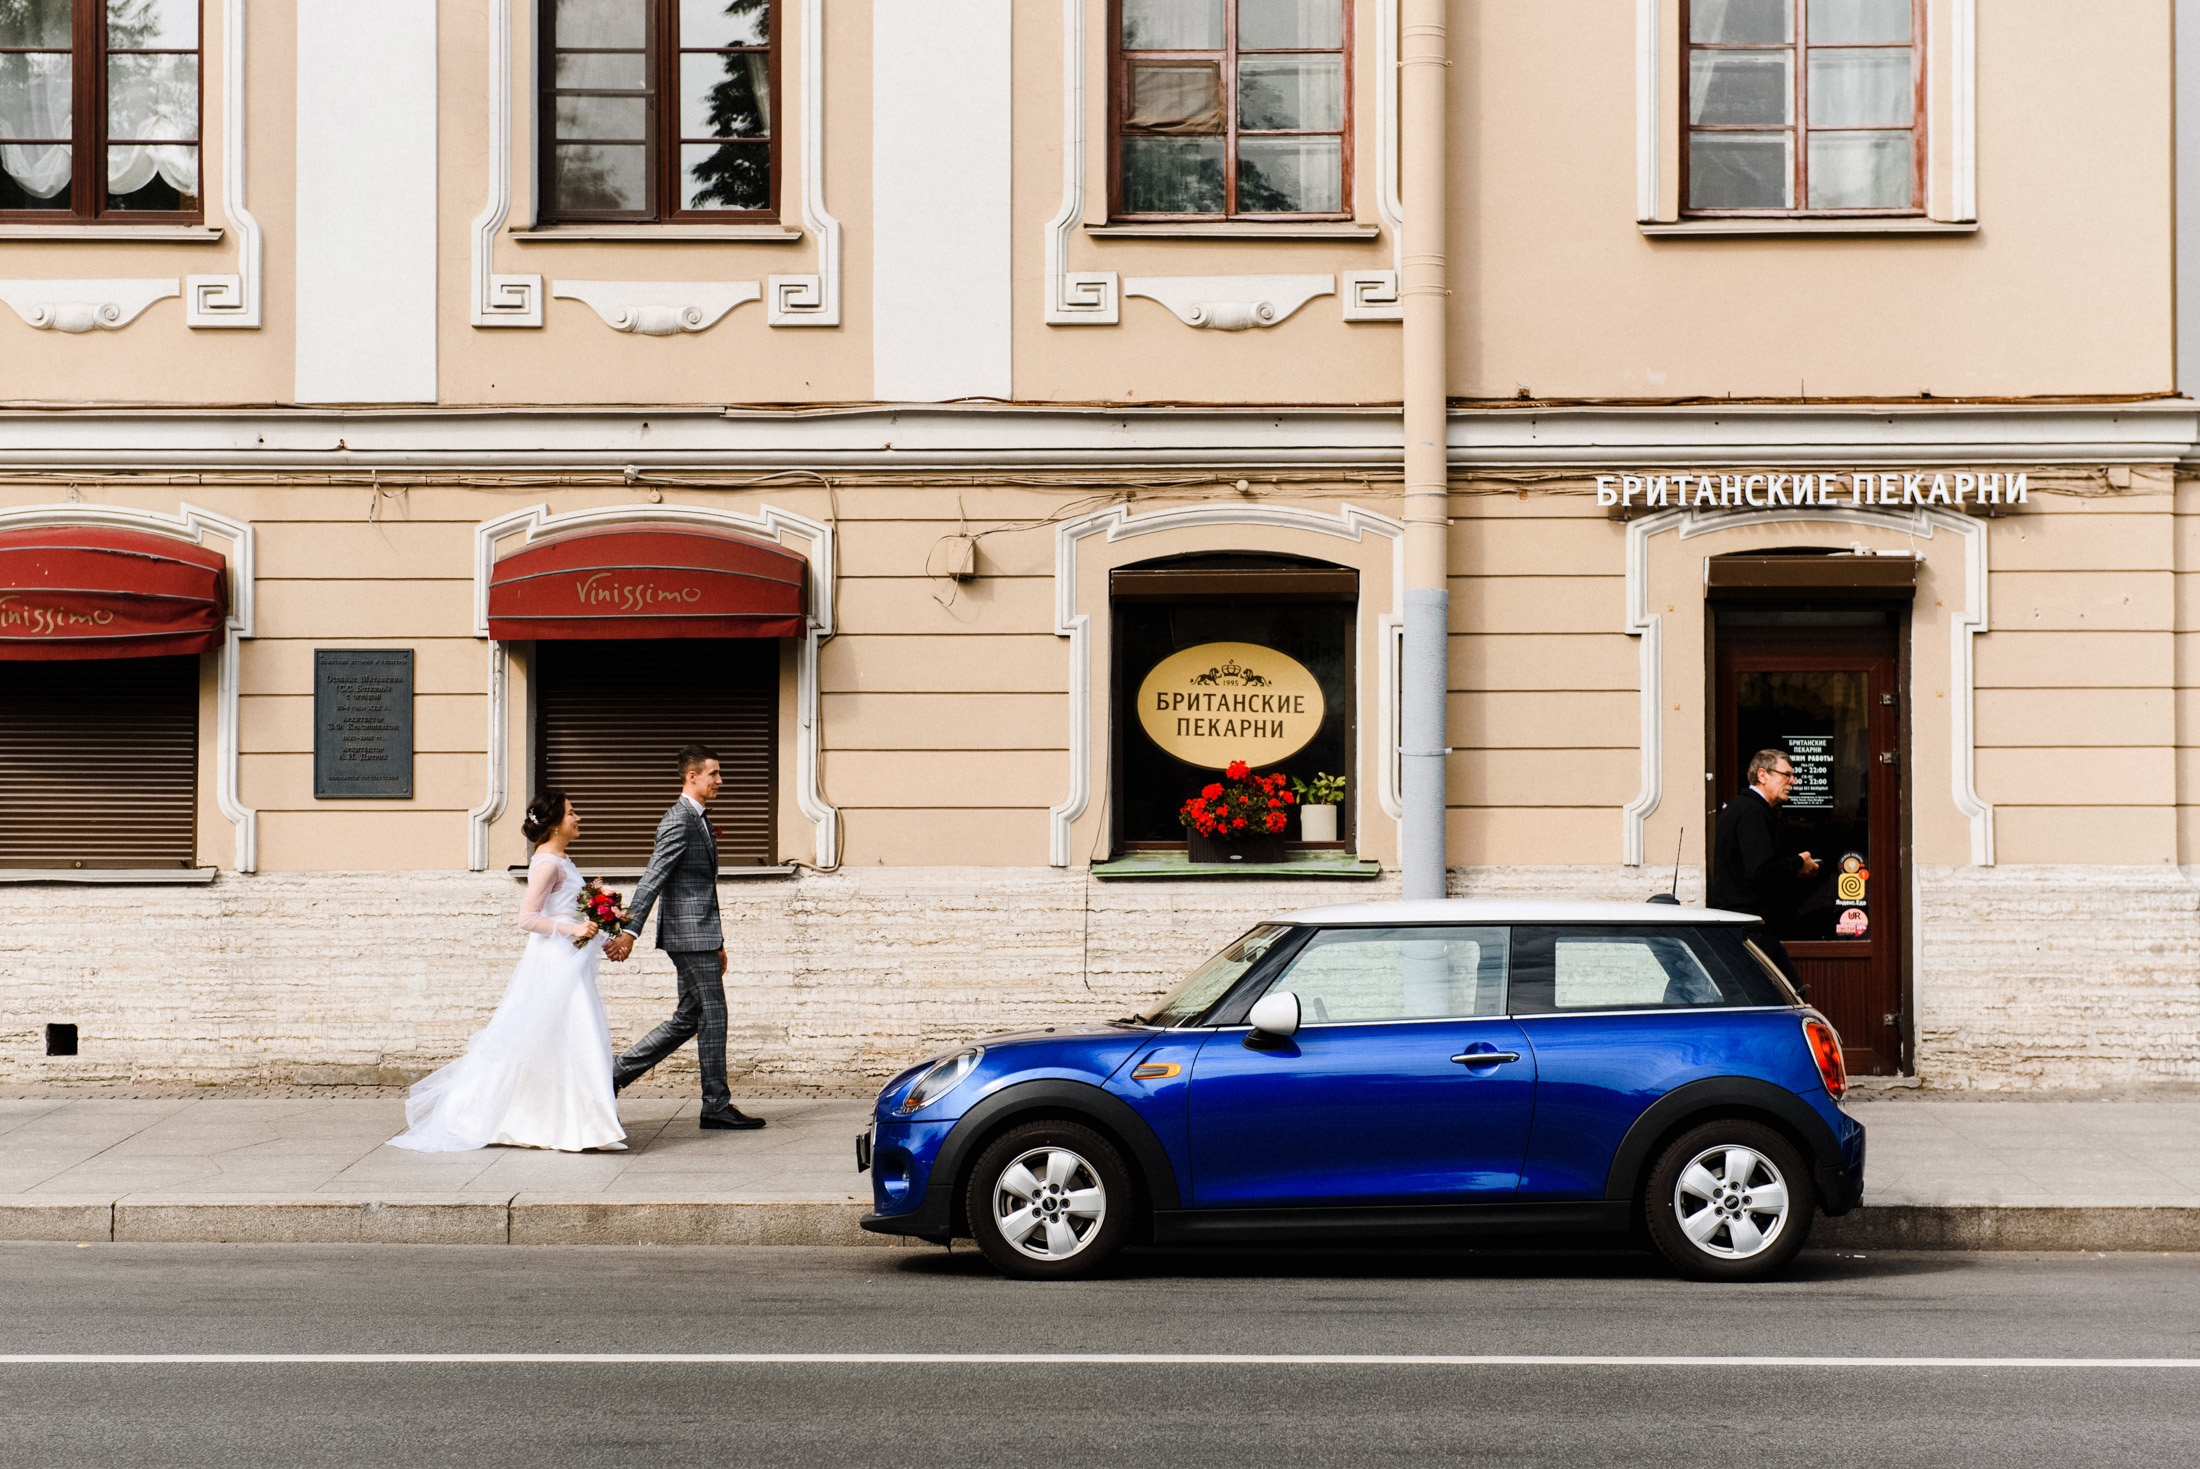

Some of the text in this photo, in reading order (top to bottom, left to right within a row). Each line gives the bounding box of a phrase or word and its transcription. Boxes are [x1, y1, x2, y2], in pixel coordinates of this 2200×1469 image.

[1595, 472, 2029, 507] БРИТАНСКИЕ ПЕКАРНИ
[576, 572, 702, 611] Vinissimo
[1156, 692, 1305, 714] БРИТАНСКИЕ
[1176, 718, 1284, 739] ПЕКАРНИ
[1847, 911, 1861, 920] UR
